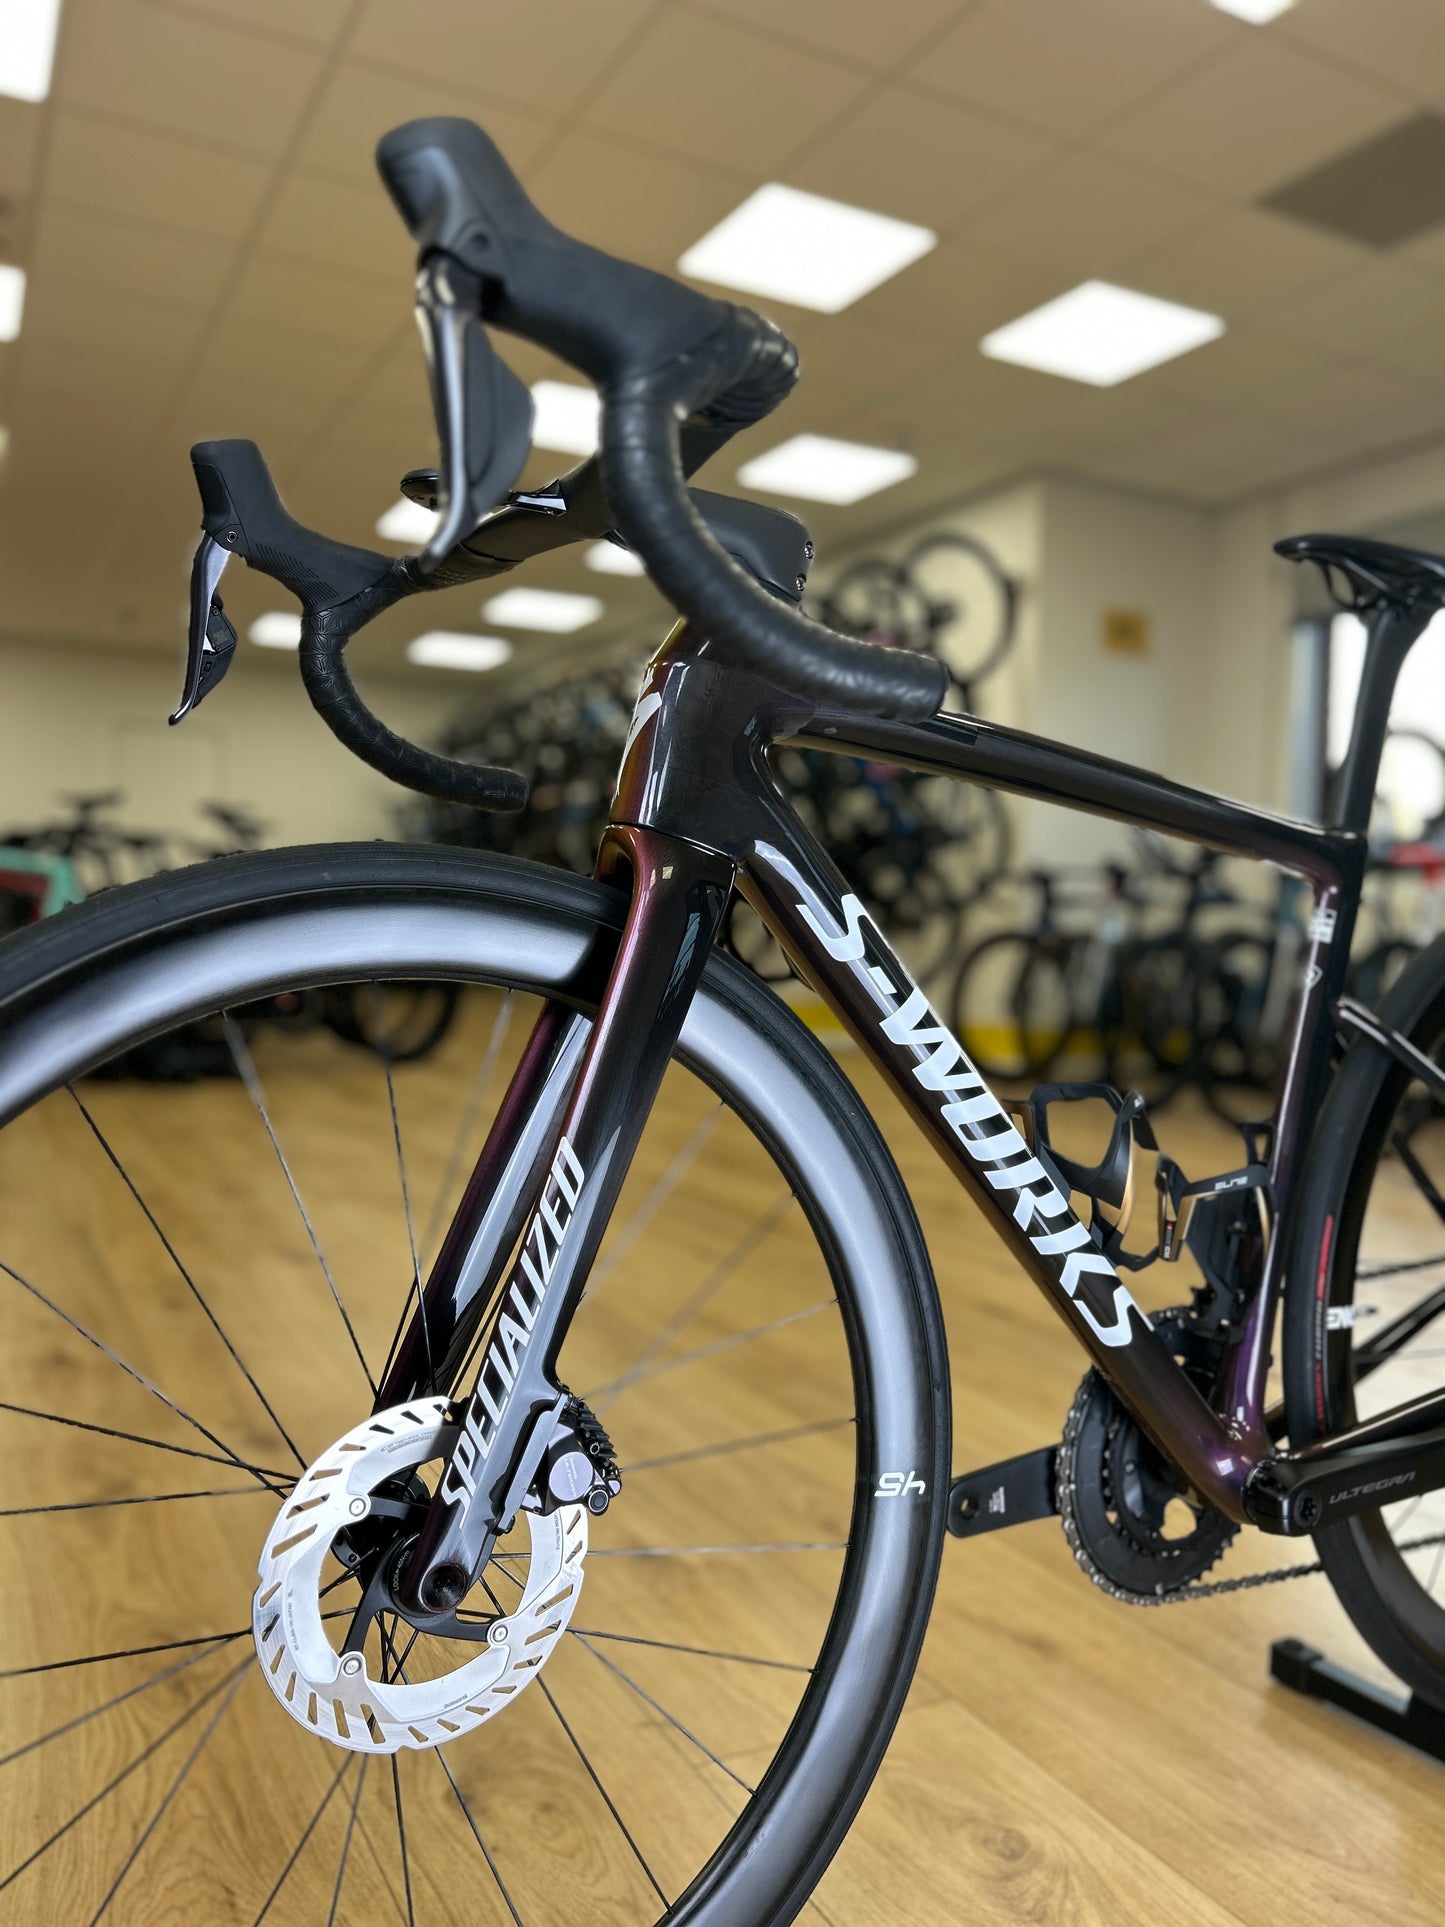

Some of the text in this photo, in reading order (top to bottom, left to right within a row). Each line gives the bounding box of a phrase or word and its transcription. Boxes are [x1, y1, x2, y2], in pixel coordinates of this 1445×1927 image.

[795, 893, 1150, 1347] S-WORKS
[440, 1135, 585, 1529] SPECIALIZED
[874, 1470, 926, 1497] 45
[1329, 1470, 1417, 1505] ULTEGRA
